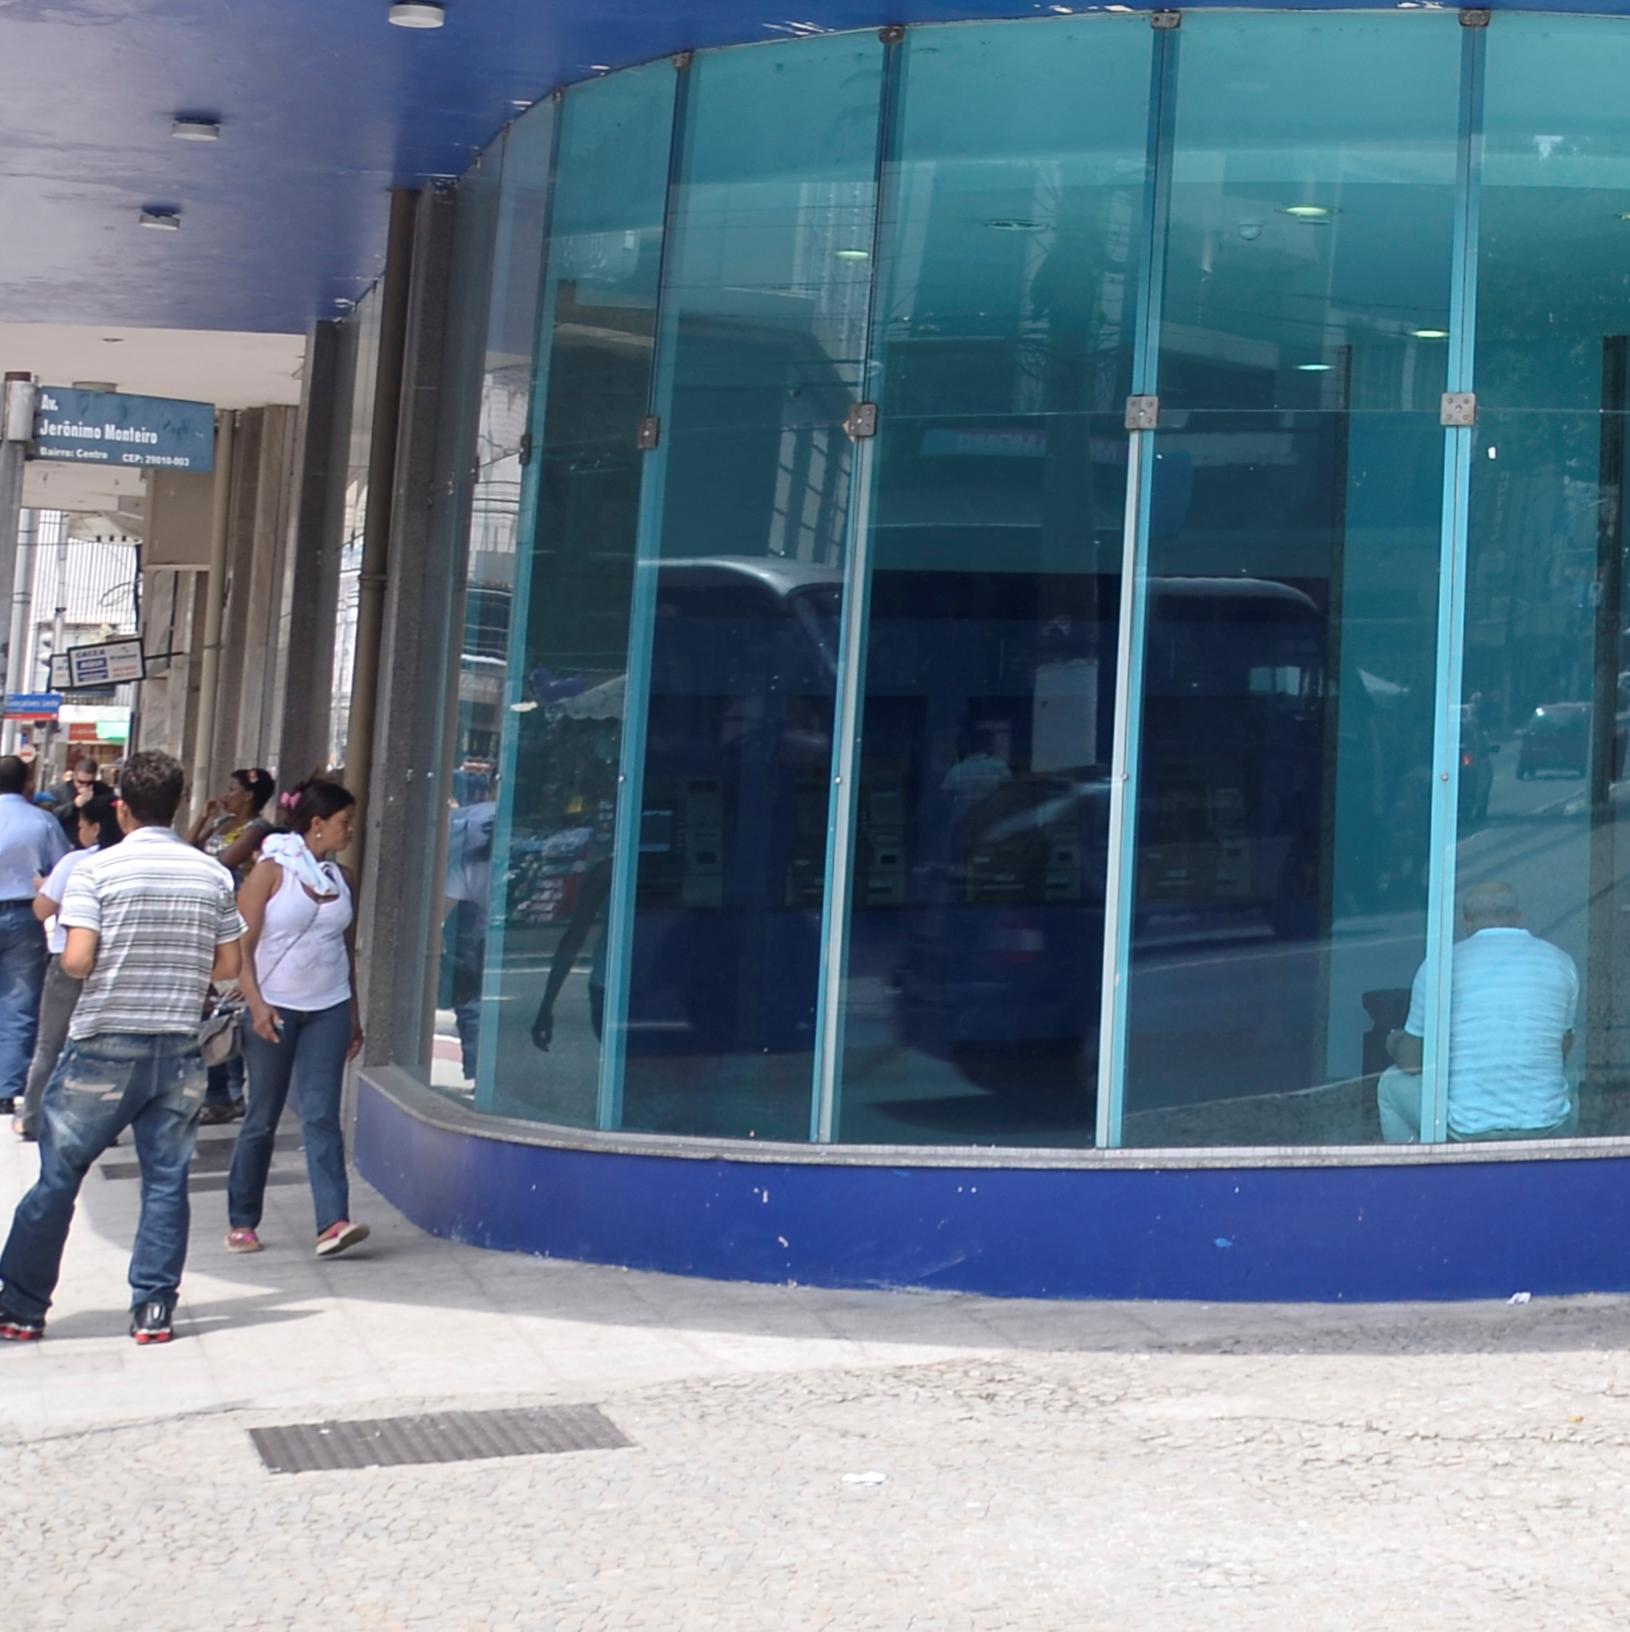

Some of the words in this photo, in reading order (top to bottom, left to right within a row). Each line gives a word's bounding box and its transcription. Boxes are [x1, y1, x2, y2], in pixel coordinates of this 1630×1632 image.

[40, 393, 59, 411] Av.
[39, 419, 102, 440] Jerônimo
[104, 423, 158, 445] Monteiro
[39, 446, 74, 458] Bairro:
[76, 448, 108, 460] Centro
[122, 453, 144, 464] CEP:
